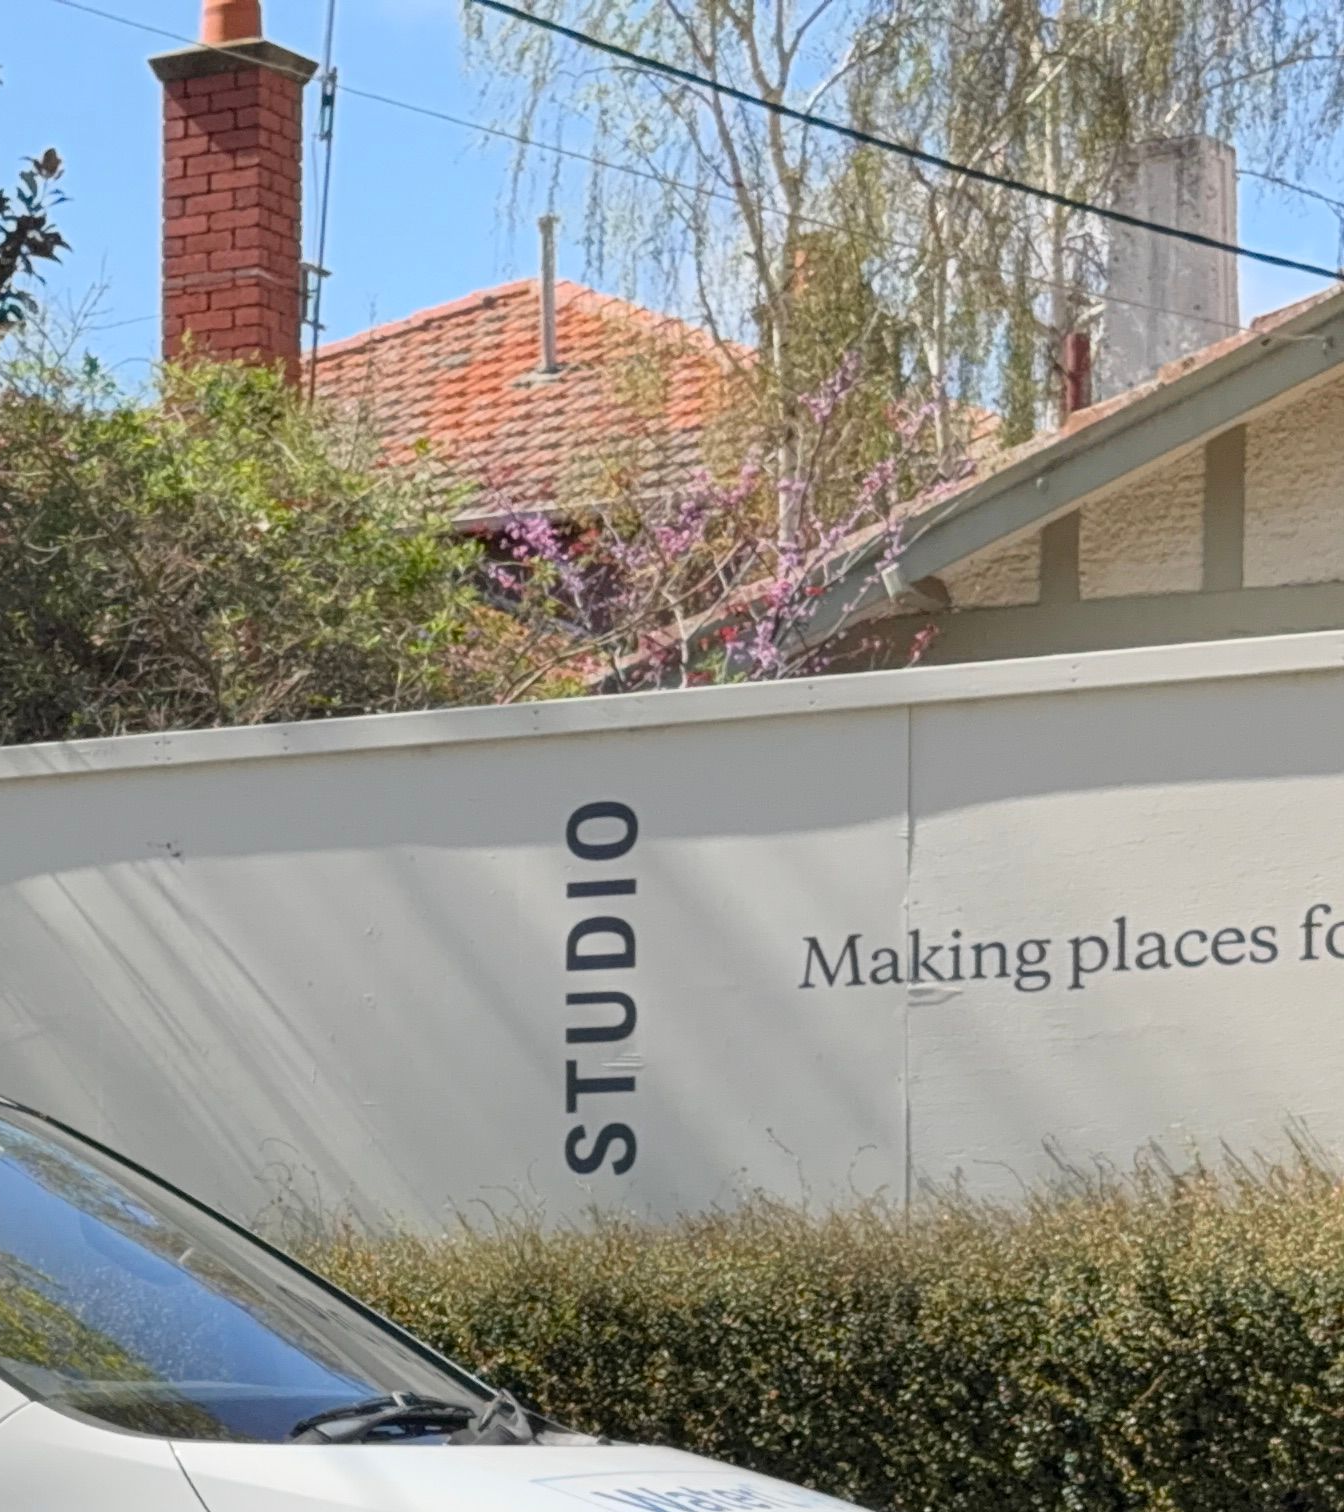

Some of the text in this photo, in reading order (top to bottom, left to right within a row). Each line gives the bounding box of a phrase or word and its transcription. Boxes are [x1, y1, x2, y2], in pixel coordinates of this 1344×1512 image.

[564, 800, 640, 1177] STUDIO
[798, 929, 1052, 992] Making
[1067, 916, 1279, 990] places
